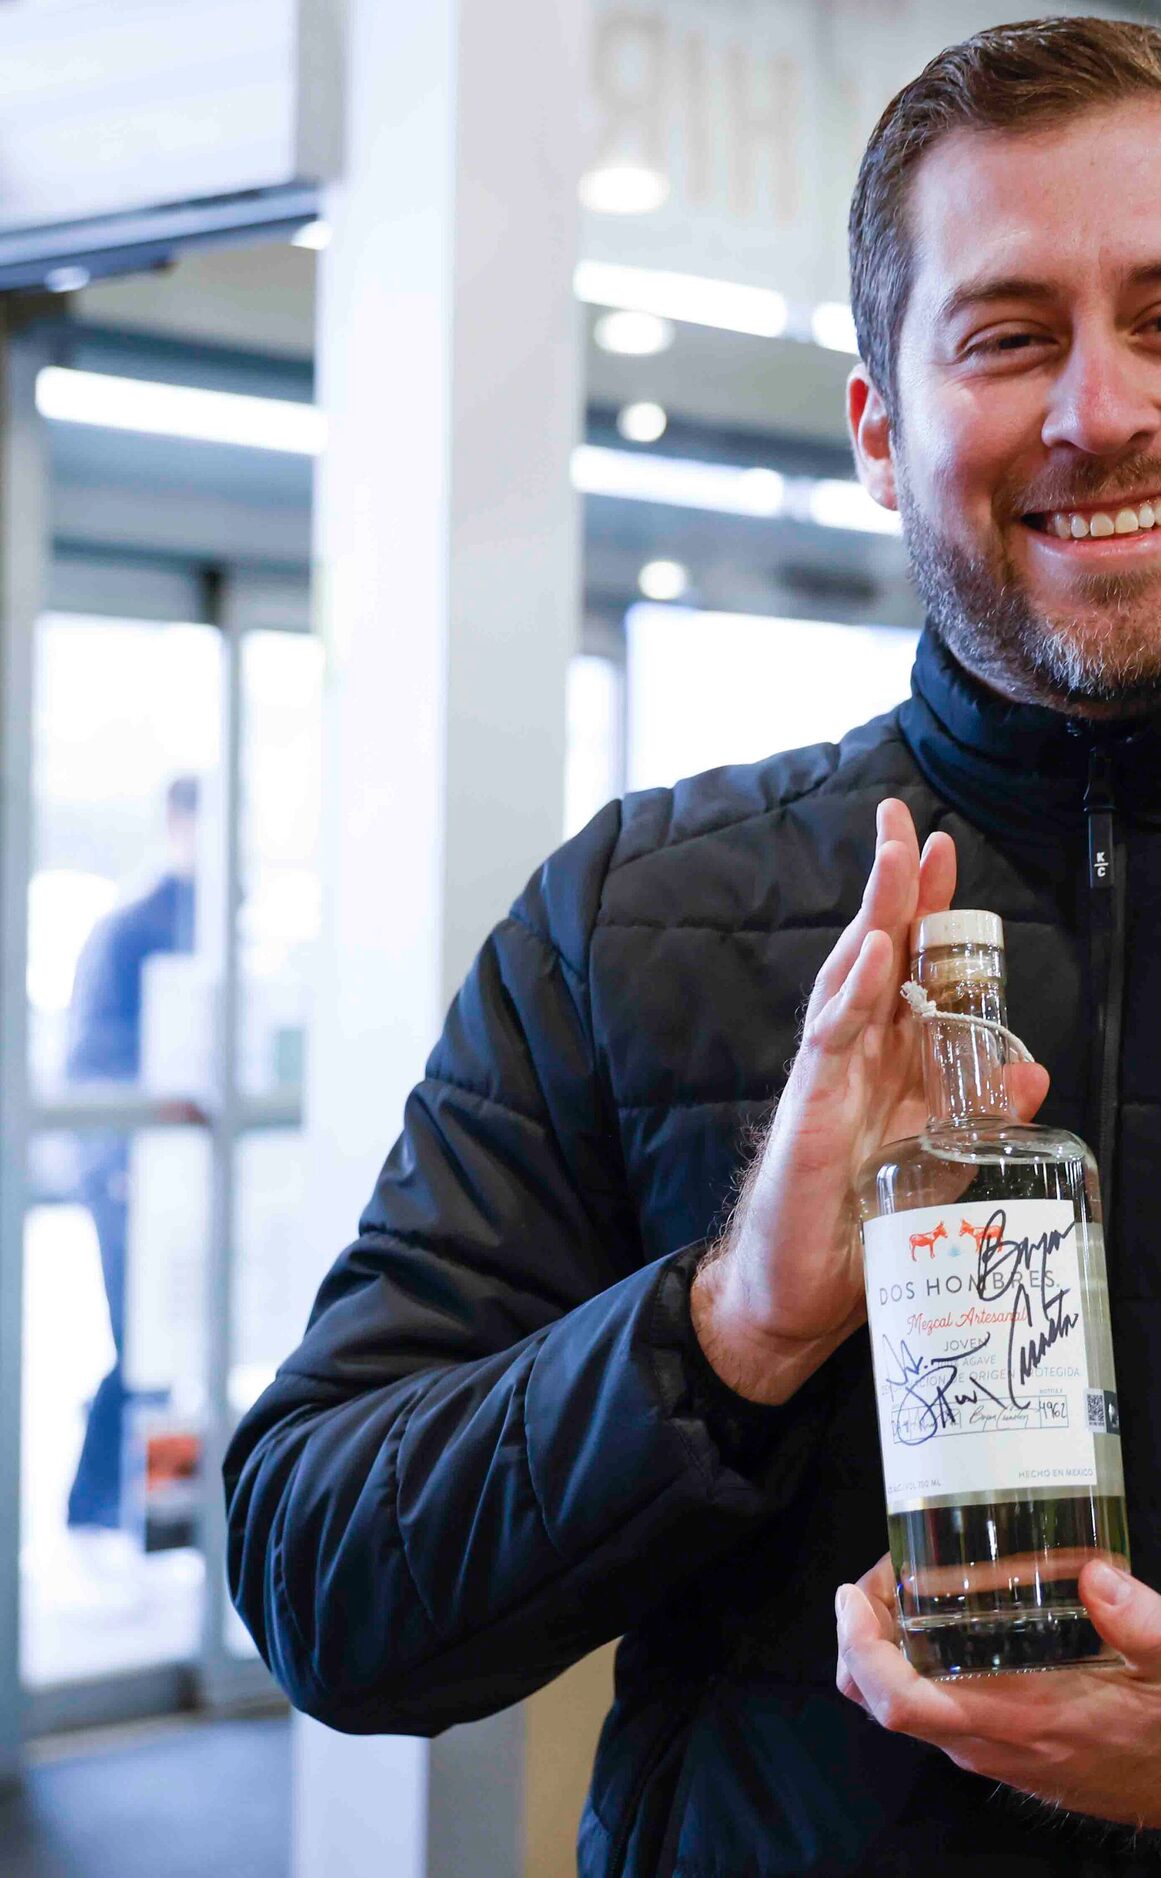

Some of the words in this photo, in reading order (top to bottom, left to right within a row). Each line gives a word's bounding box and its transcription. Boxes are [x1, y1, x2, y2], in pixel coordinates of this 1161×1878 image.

[879, 1281, 915, 1306] DOS
[907, 1311, 953, 1336] Mezcal
[955, 1307, 1027, 1328] Artesanal
[943, 1337, 989, 1352] JOVEN
[962, 1354, 997, 1367] AGAVE
[1018, 1468, 1051, 1479] HECHO
[1052, 1467, 1064, 1478] EN
[1065, 1467, 1094, 1478] MEXICO
